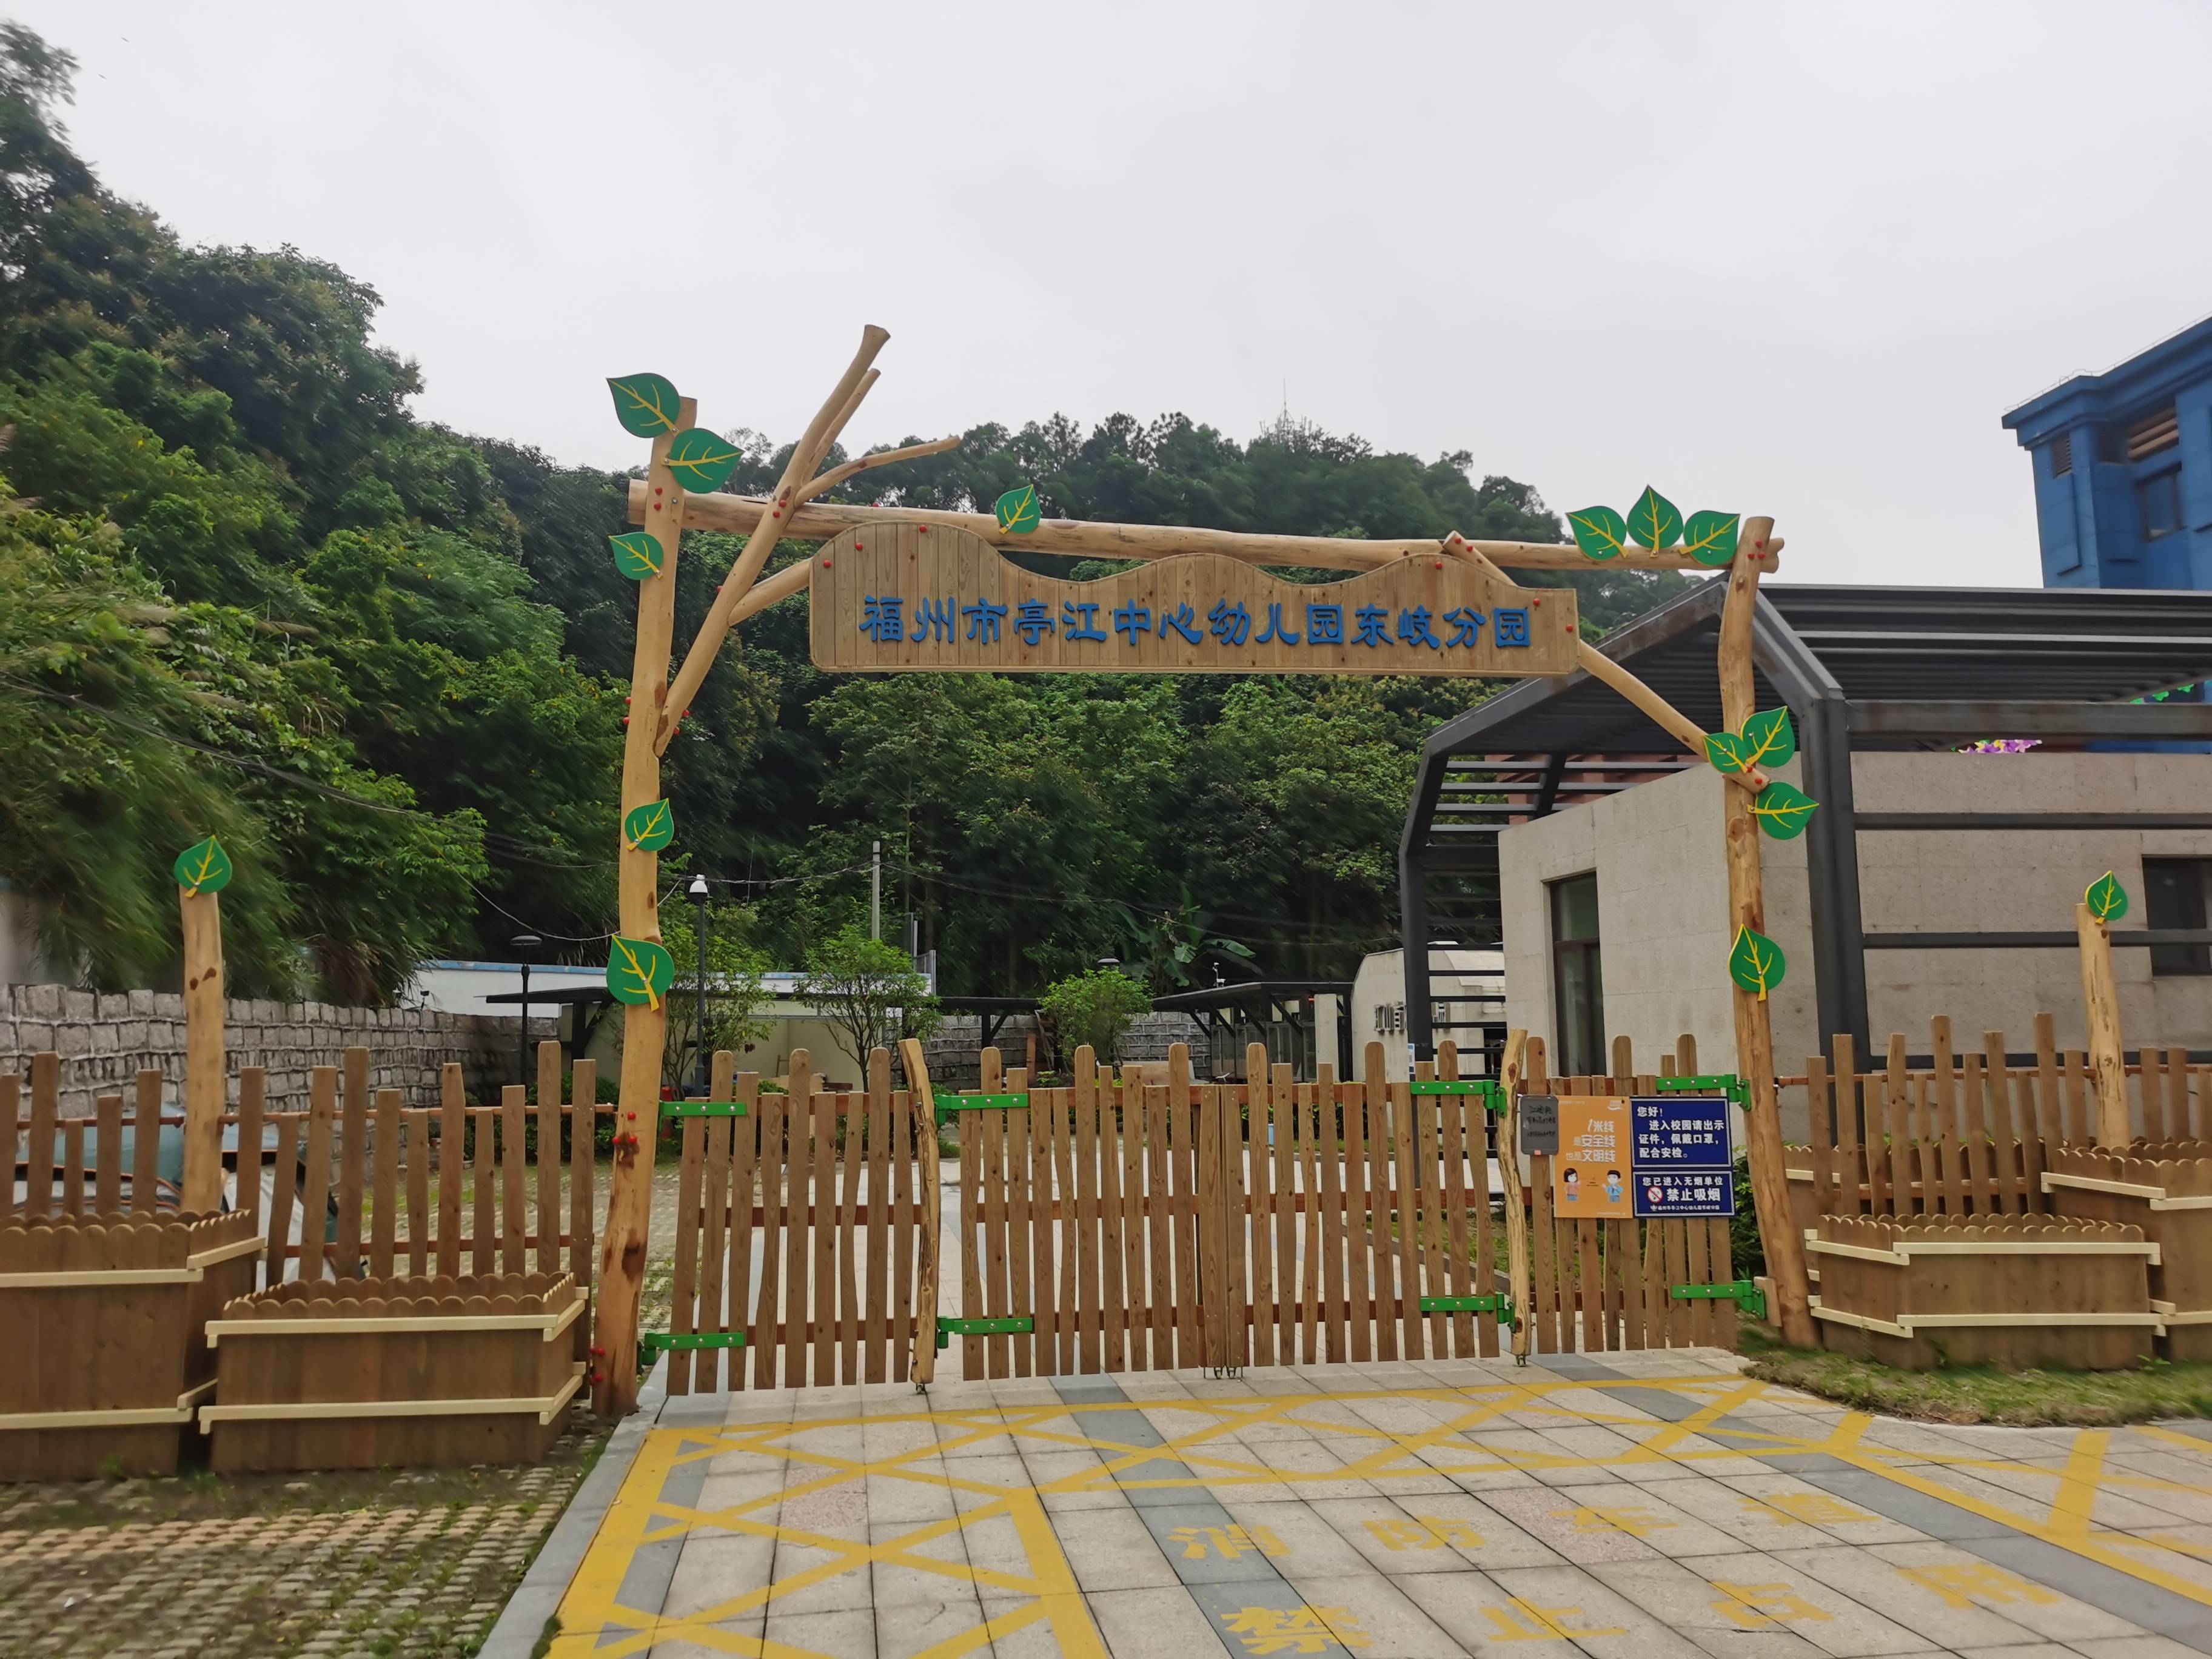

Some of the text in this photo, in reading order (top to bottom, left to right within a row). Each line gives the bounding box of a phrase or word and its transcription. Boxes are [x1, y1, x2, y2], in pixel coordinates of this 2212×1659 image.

[859, 595, 1530, 648] 福州市亭江中心幼儿园东岐分园
[1637, 1106, 1663, 1117] 您好！
[1587, 1119, 1614, 1132] 1米线
[1649, 1120, 1725, 1131] 进入校园请出示
[1638, 1133, 1718, 1144] 证件，佩戴口罩，
[1639, 1147, 1688, 1158] 配合安检。
[1643, 1176, 1723, 1186] 您已进入无烟单位
[1667, 1188, 1721, 1202] 禁止吸烟
[1221, 1562, 2061, 1656] 禁止占用
